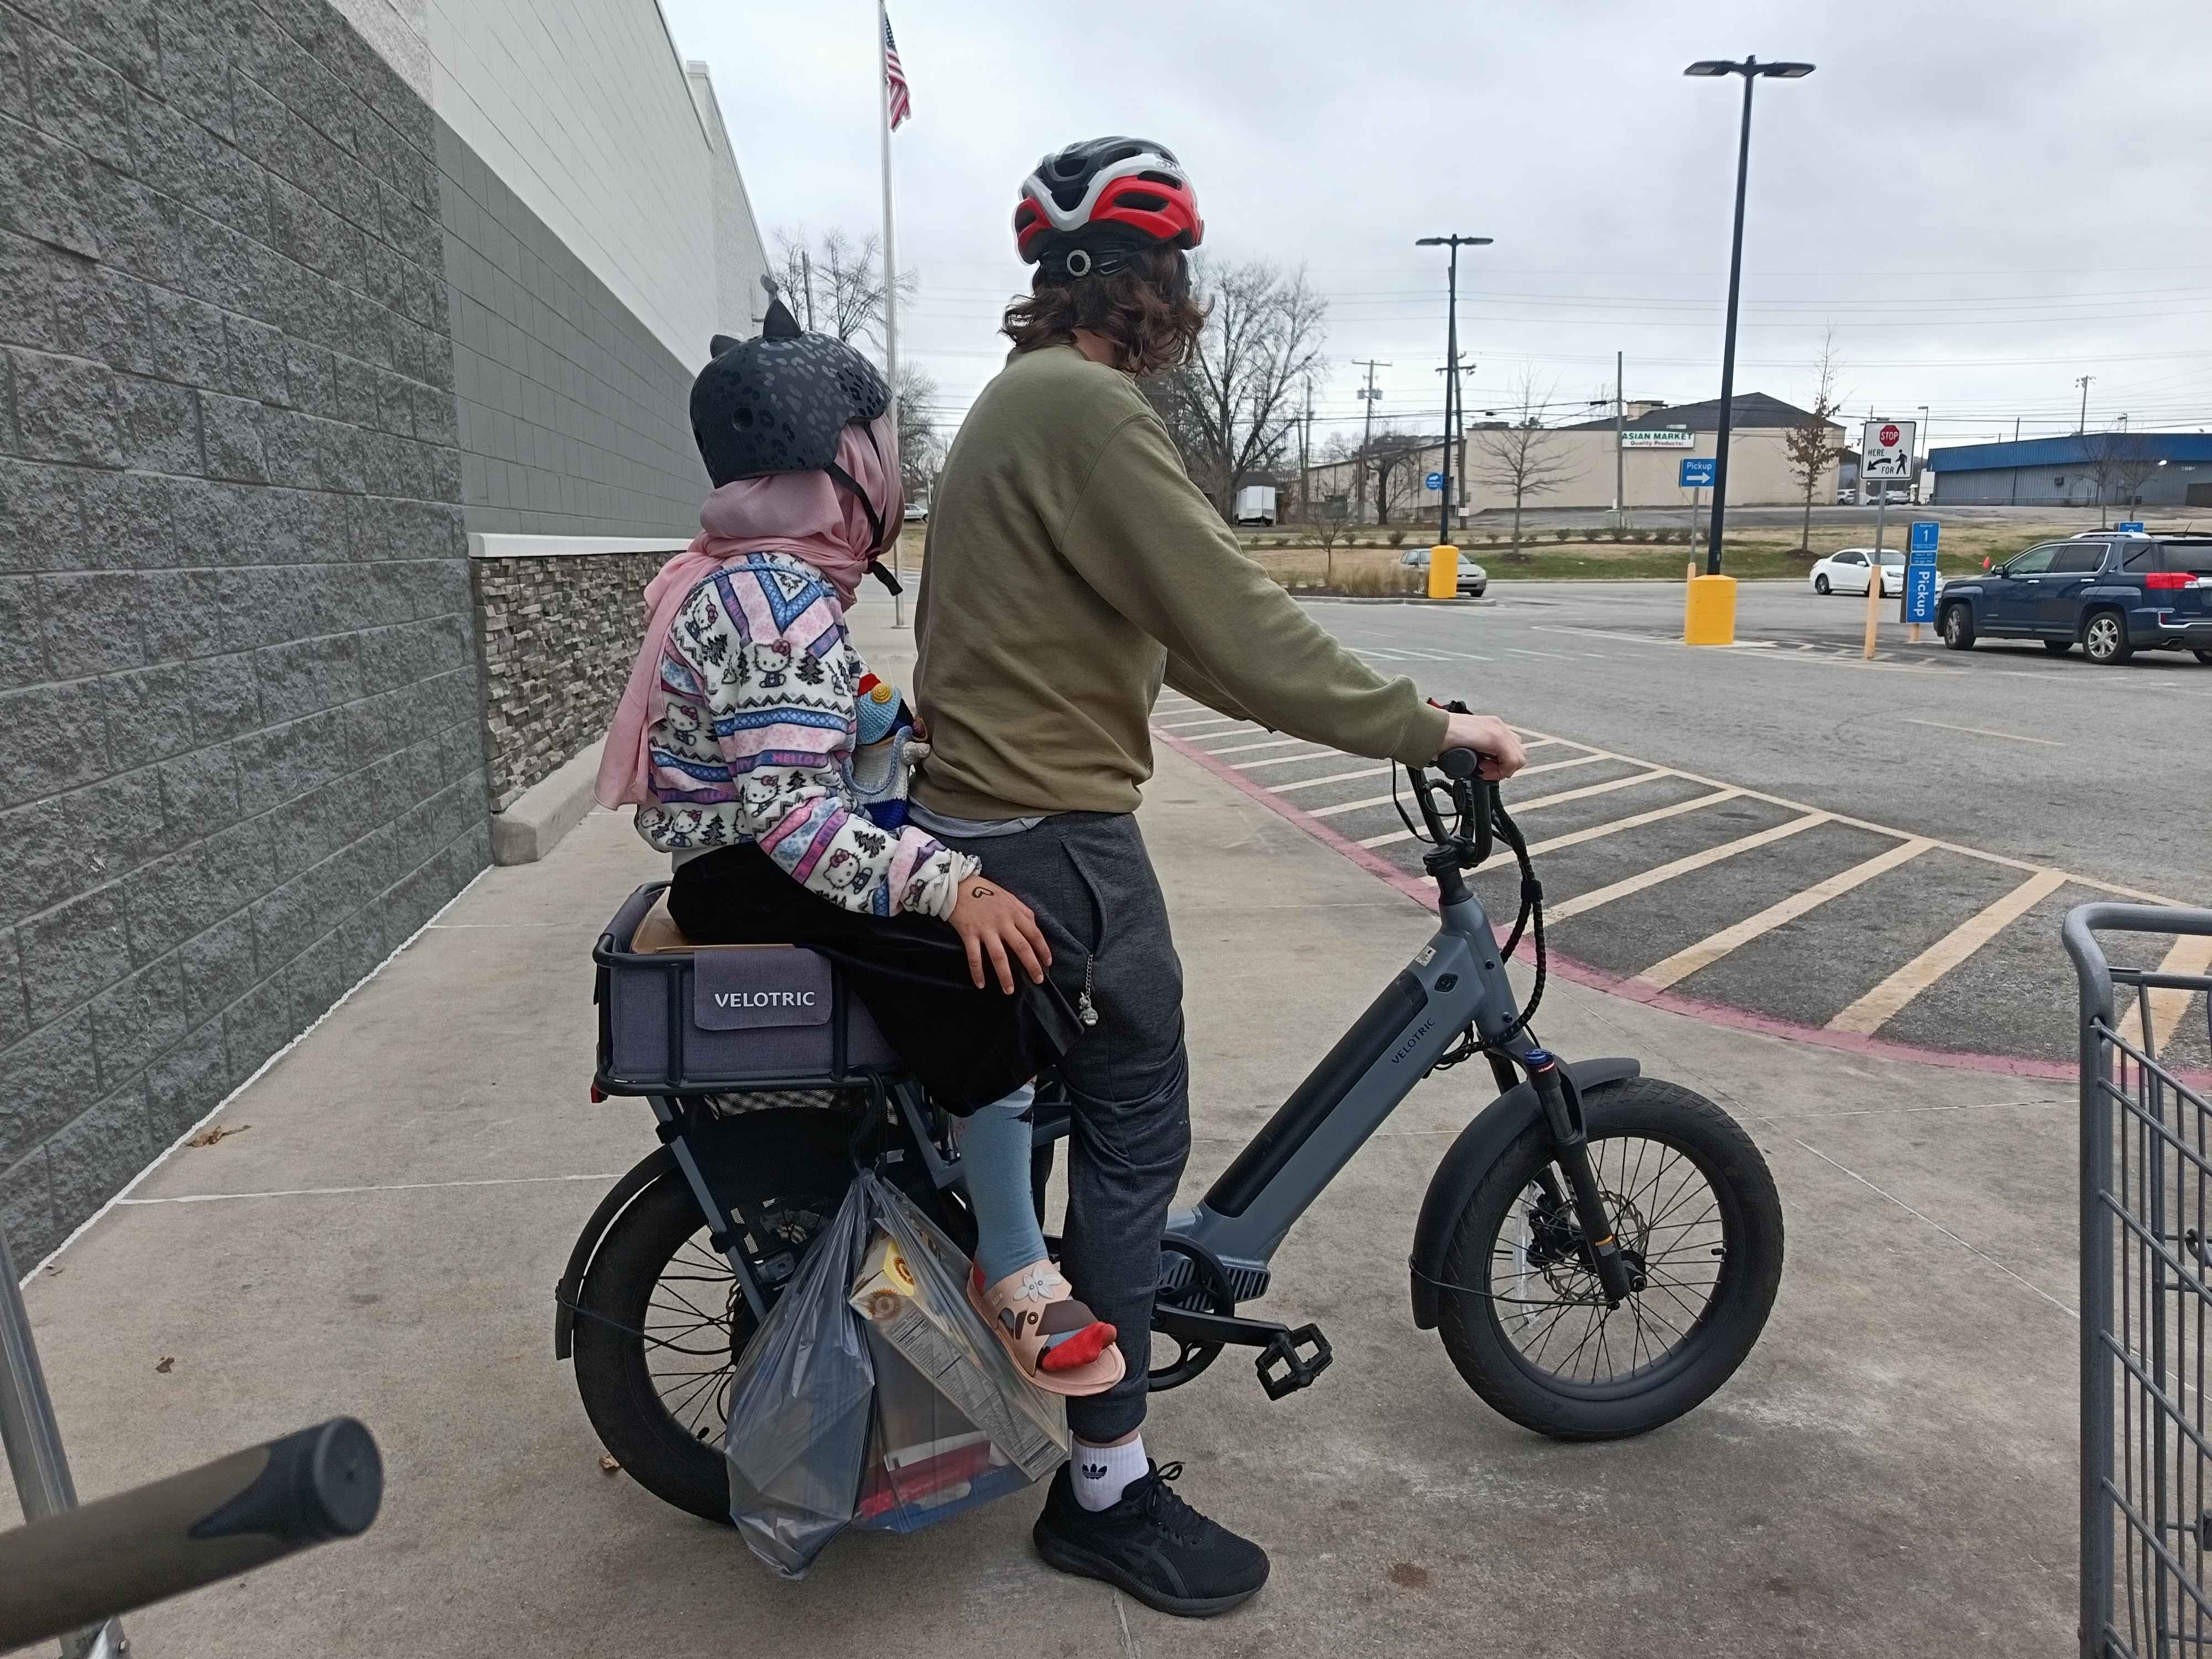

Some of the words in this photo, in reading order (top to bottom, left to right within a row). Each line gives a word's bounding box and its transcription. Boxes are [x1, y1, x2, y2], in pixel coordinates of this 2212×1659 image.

[1880, 431, 1898, 440] STOP
[1867, 448, 1885, 457] HERE
[1687, 461, 1712, 472] Pickup
[1881, 466, 1894, 474] FOR
[1923, 529, 1928, 542] 1
[1913, 571, 1930, 617] Pickup
[714, 992, 815, 1008] VELOTRIC
[1391, 1017, 1436, 1063] VELOTRIC
